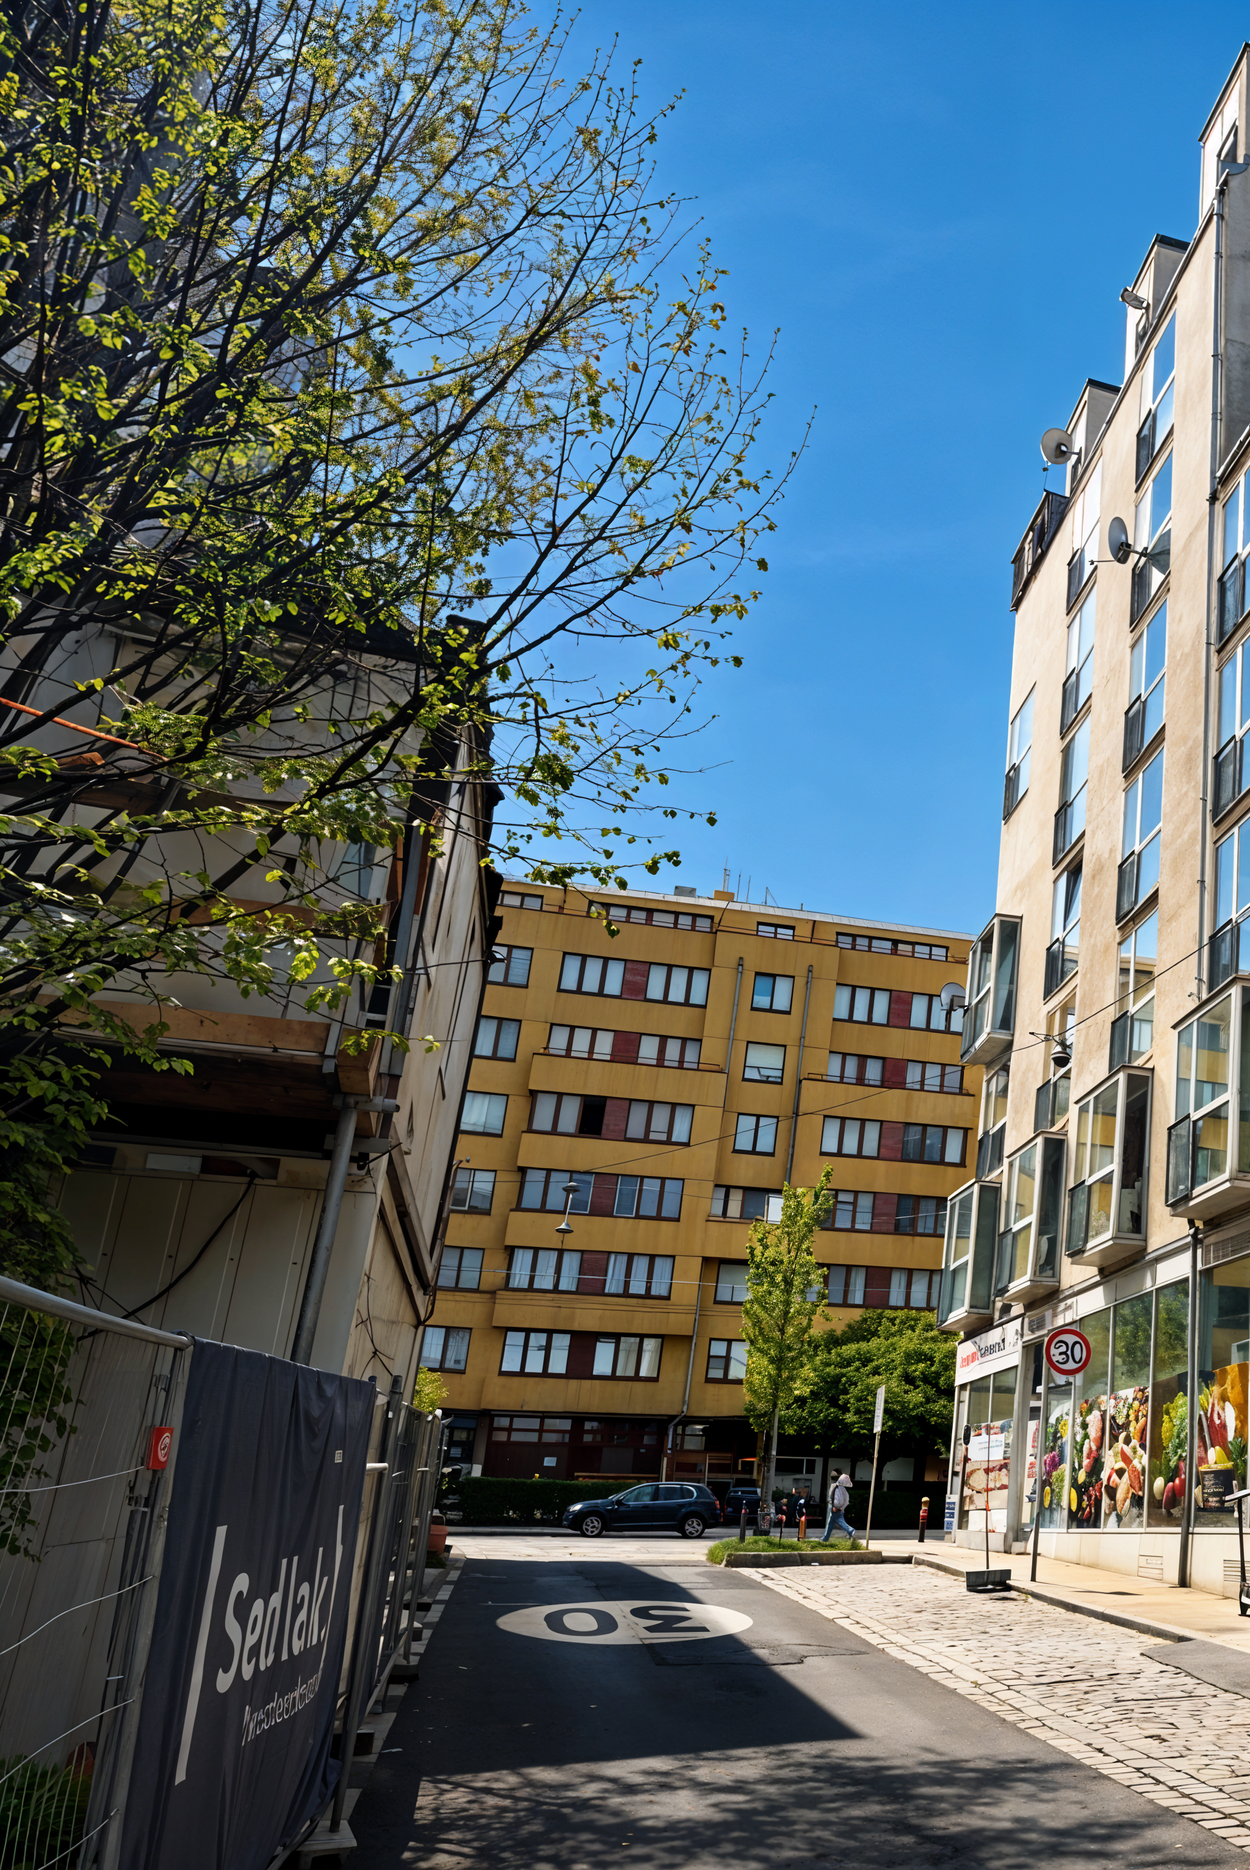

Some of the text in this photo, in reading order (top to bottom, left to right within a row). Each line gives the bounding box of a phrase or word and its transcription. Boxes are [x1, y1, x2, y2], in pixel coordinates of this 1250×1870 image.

[1053, 1339, 1083, 1365] 30
[215, 1546, 329, 1694] Sedlak
[543, 1605, 711, 1637] 30
